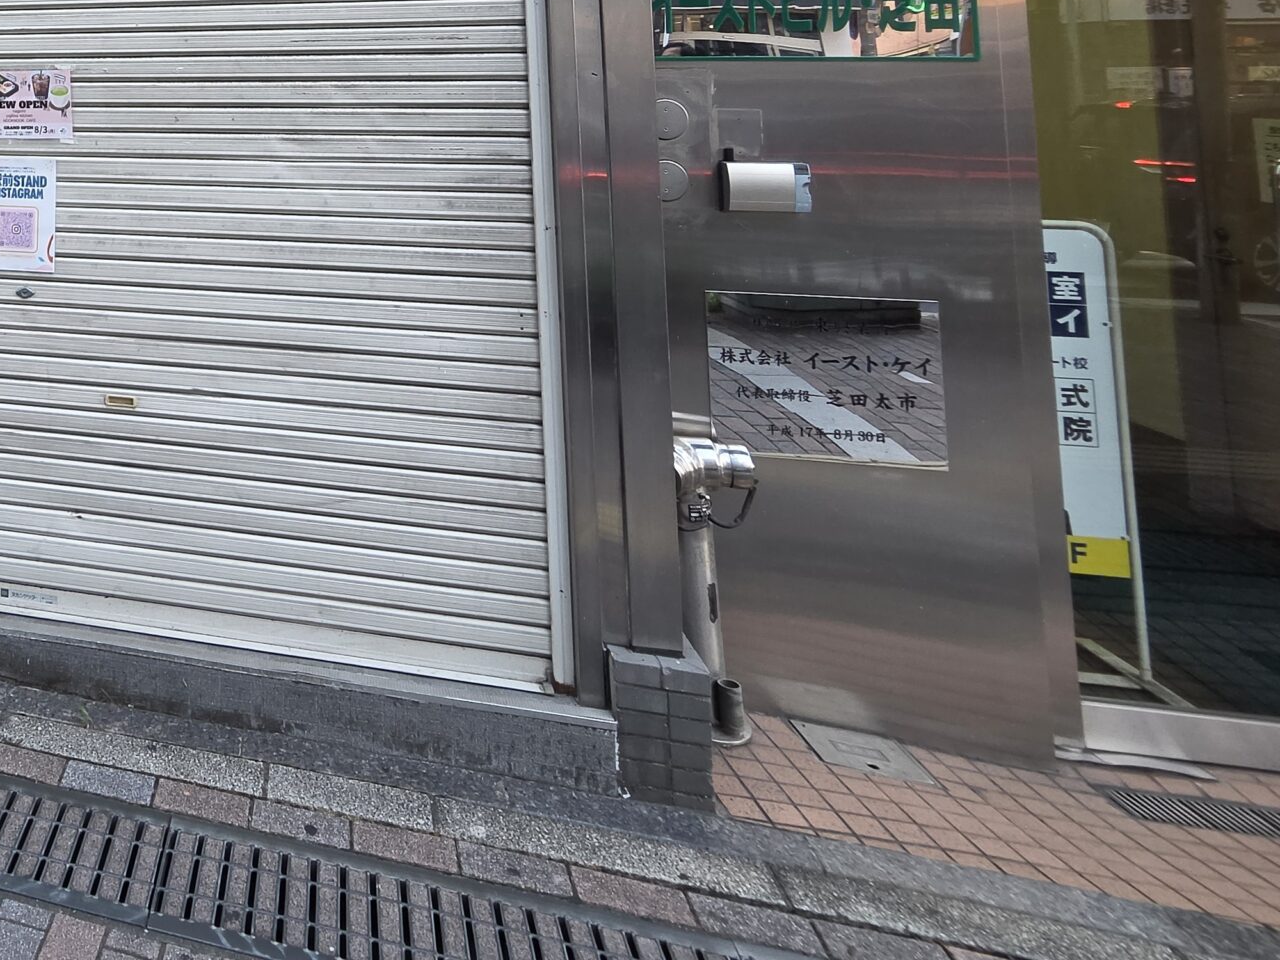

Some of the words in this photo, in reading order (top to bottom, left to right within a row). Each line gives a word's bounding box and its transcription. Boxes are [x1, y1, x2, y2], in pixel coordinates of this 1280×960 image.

[19, 100, 48, 109] OPEN
[34, 125, 48, 134] 8/3
[1051, 275, 1082, 300] 室
[1056, 309, 1080, 333] イ
[720, 348, 792, 366] 株式会社
[803, 353, 933, 376] イースト・ケイ
[736, 385, 812, 403] 代表取締役
[826, 390, 918, 413] 芝田太市
[1061, 383, 1090, 408] 式
[1063, 416, 1093, 443] 院
[1070, 542, 1087, 564] F
